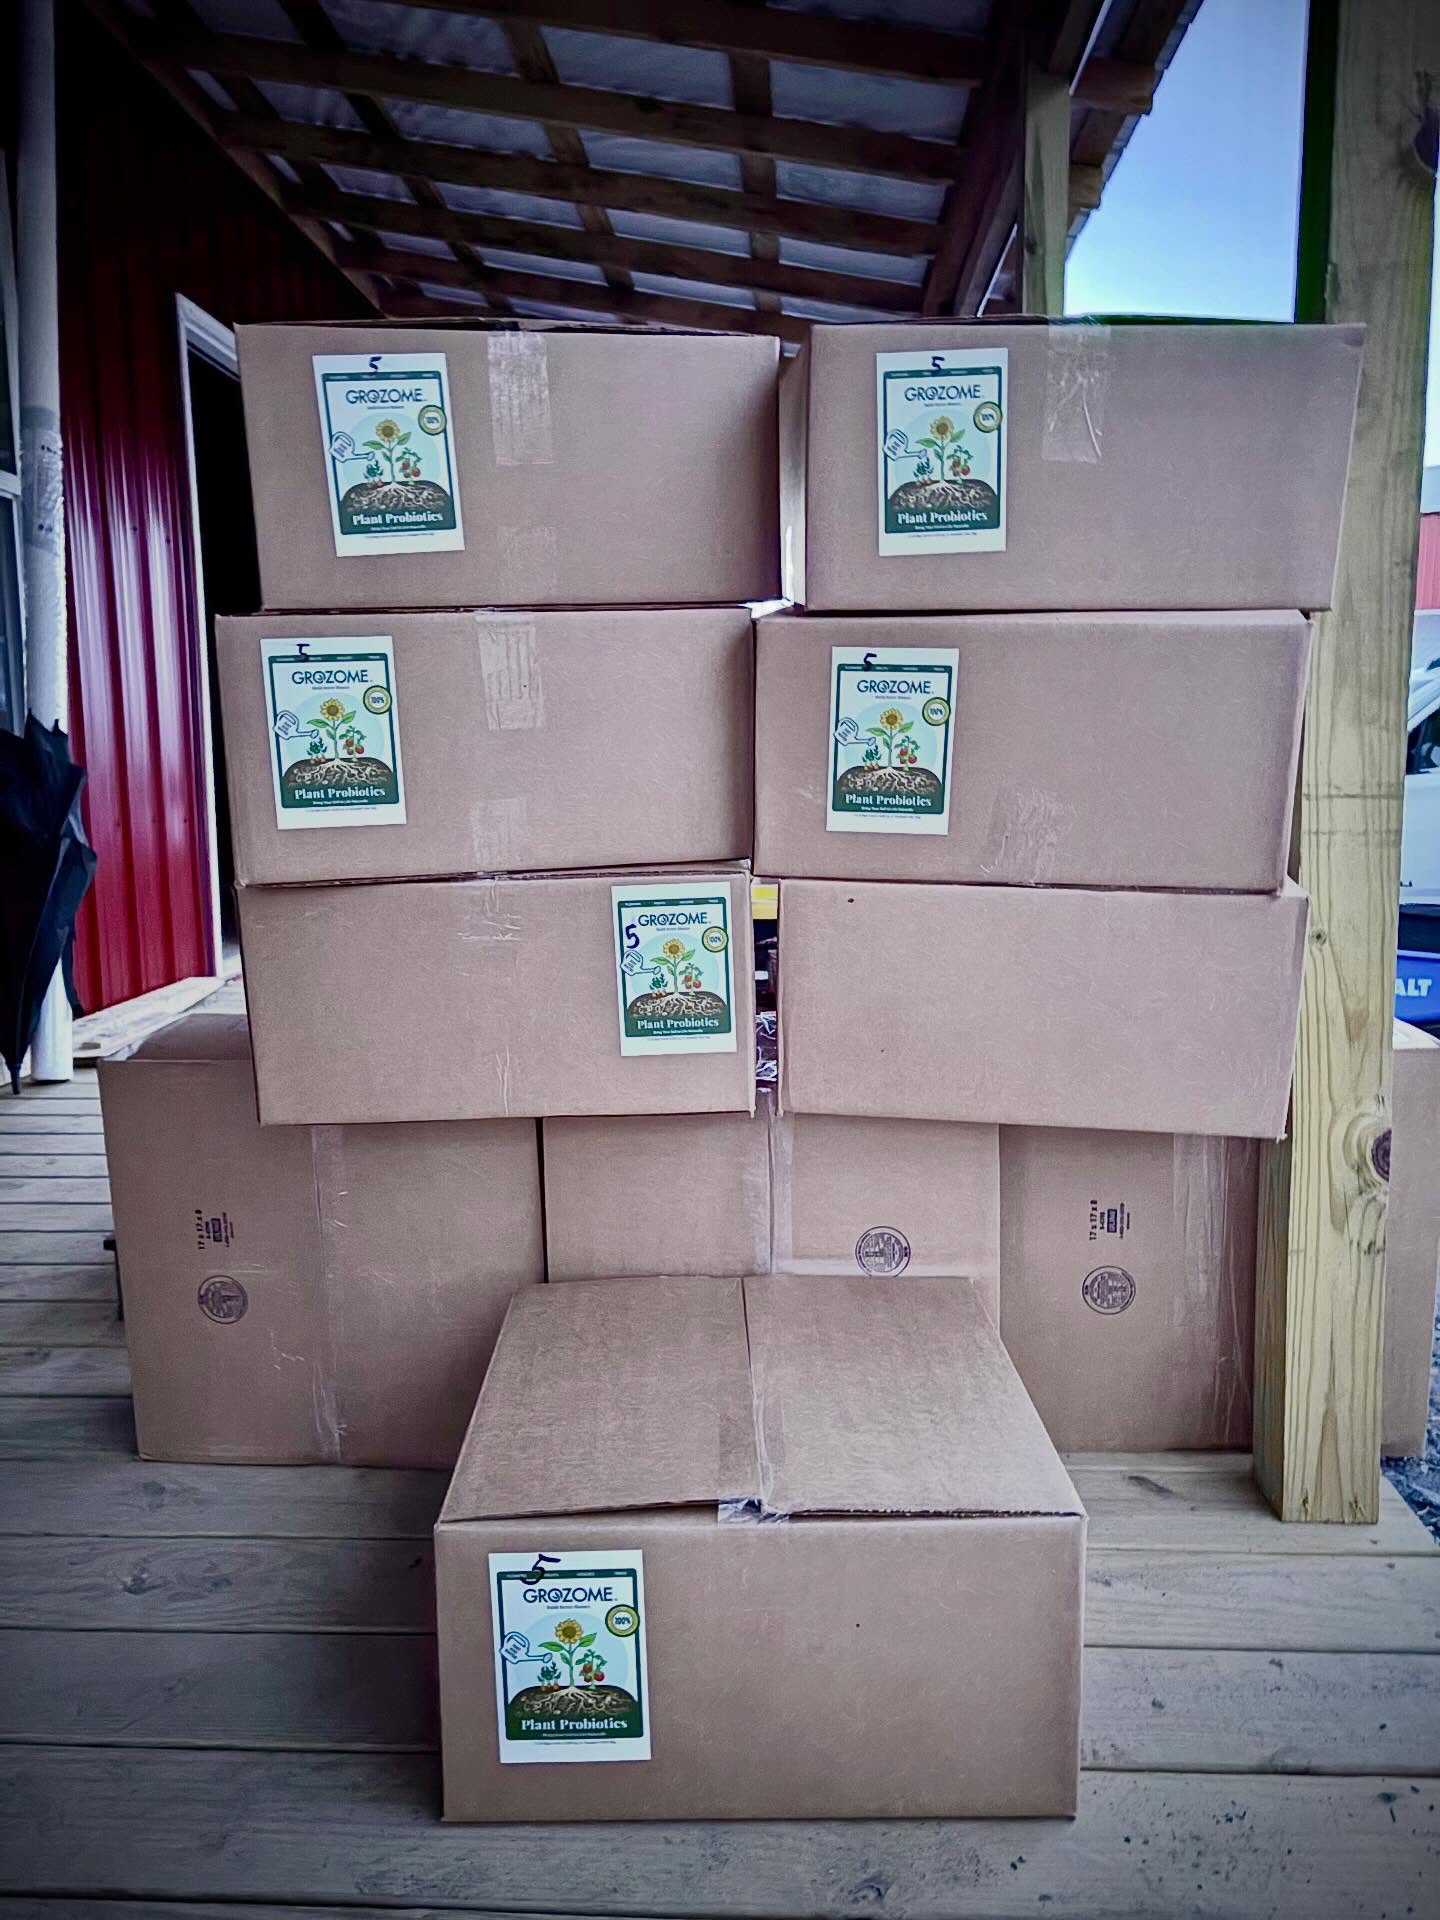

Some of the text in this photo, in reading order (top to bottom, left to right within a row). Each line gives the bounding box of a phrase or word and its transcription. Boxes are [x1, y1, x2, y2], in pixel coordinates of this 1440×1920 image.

[345, 388, 424, 404] GROZOME
[904, 384, 981, 402] GROZOME
[352, 511, 444, 526] Plant Probiotics
[898, 510, 988, 524] Plant Probiotics
[292, 669, 368, 685] GROZOME
[856, 680, 932, 694] GROZOME
[294, 786, 386, 800] Plant Probiotics
[845, 794, 932, 807] Plant Probiotics
[638, 912, 708, 927] GROZOME
[625, 924, 640, 949] 5
[637, 1017, 720, 1030] Plant Probiotics
[520, 1553, 562, 1585] 5
[523, 1586, 614, 1603] GROZOME
[614, 1616, 631, 1626] 100%
[521, 1717, 628, 1731] Plant Probiotics
